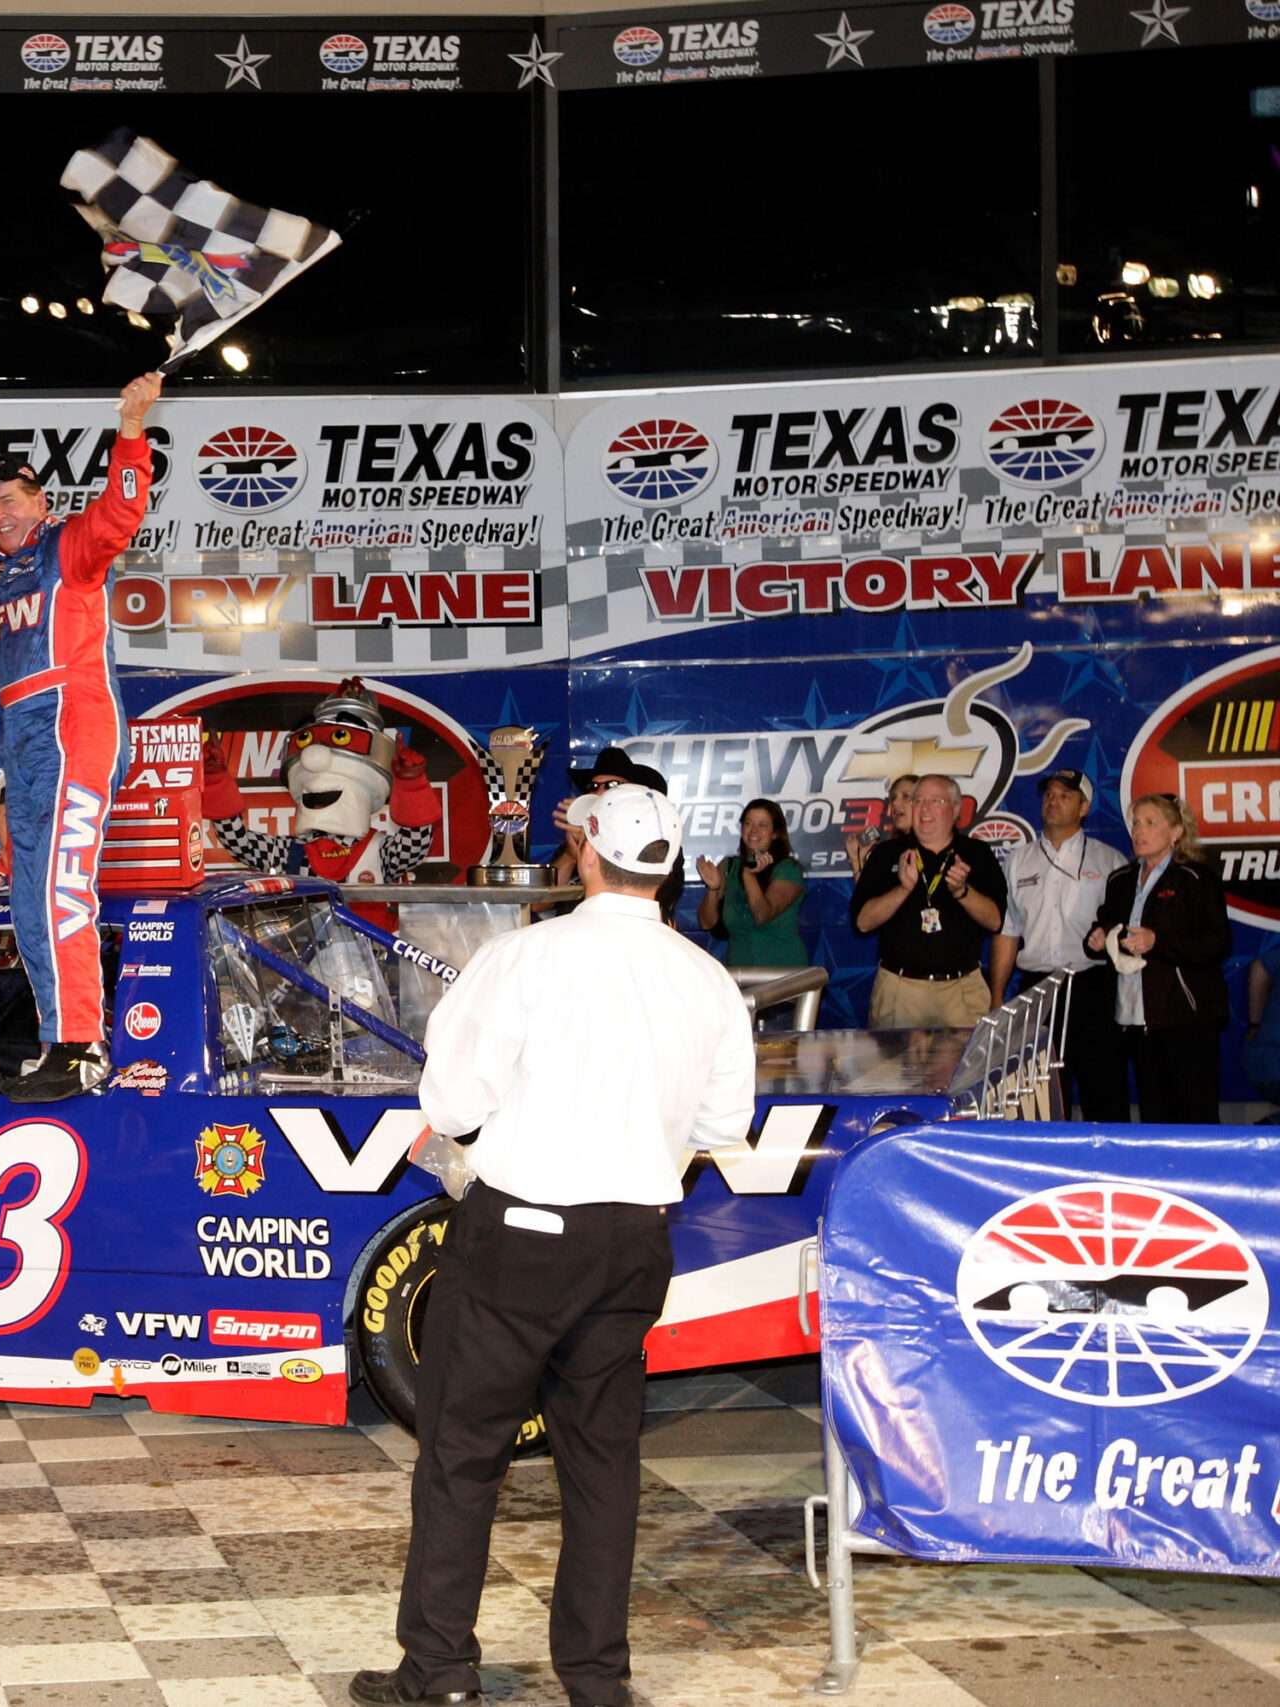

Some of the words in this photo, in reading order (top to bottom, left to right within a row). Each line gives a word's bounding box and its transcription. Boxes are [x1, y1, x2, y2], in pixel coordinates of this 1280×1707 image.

[981, 0, 1074, 28] TEXAS
[669, 20, 759, 51] TEXAS
[981, 28, 1017, 40] MOTOR
[1019, 25, 1070, 37] SPEEDWAY
[75, 36, 164, 61] TEXAS
[373, 36, 460, 61] TEXAS
[669, 51, 703, 62] MOTOR
[705, 48, 755, 60] SPEEDWAY
[76, 63, 108, 71] MOTOR
[111, 63, 160, 71] SPEEDWAY
[373, 63, 406, 71] MOTOR
[408, 63, 456, 72] SPEEDWAY
[1118, 388, 1280, 452] TEX
[731, 403, 958, 473] TEXAS
[320, 422, 534, 482] TEXAS
[1121, 456, 1208, 478] MOTOR
[733, 476, 817, 497] MOTOR
[823, 468, 951, 493] SPEEDWAY
[322, 488, 402, 508] MOTOR
[408, 485, 527, 506] SPEEDWAY
[986, 499, 1024, 524] The
[1036, 495, 1101, 522] Great
[1108, 490, 1221, 518] American
[195, 522, 233, 548] The
[241, 520, 304, 548] Great
[309, 519, 412, 547] American
[421, 516, 539, 548] Speedway!
[604, 516, 642, 542] The
[651, 512, 714, 540] Great
[722, 507, 830, 538] American
[838, 498, 963, 534] Speedway!
[639, 552, 1037, 619] VICTORY
[1058, 545, 1280, 602] LANE
[308, 571, 535, 626] LANE
[143, 743, 200, 763] WINNER
[111, 803, 149, 811] RAFTSMAN
[55, 783, 104, 941] VFW
[128, 931, 173, 942] WORLD
[129, 921, 174, 931] CAMPING
[130, 1004, 158, 1033] Rheem
[196, 1215, 330, 1246] CAMPING
[198, 1245, 331, 1280] WORLD
[116, 1312, 202, 1339] VFW
[213, 1317, 316, 1341] Snap-on
[183, 1361, 218, 1373] Miller
[286, 1367, 316, 1376] PENNZOIL
[975, 1436, 1073, 1503] The
[1094, 1436, 1261, 1517] Great
